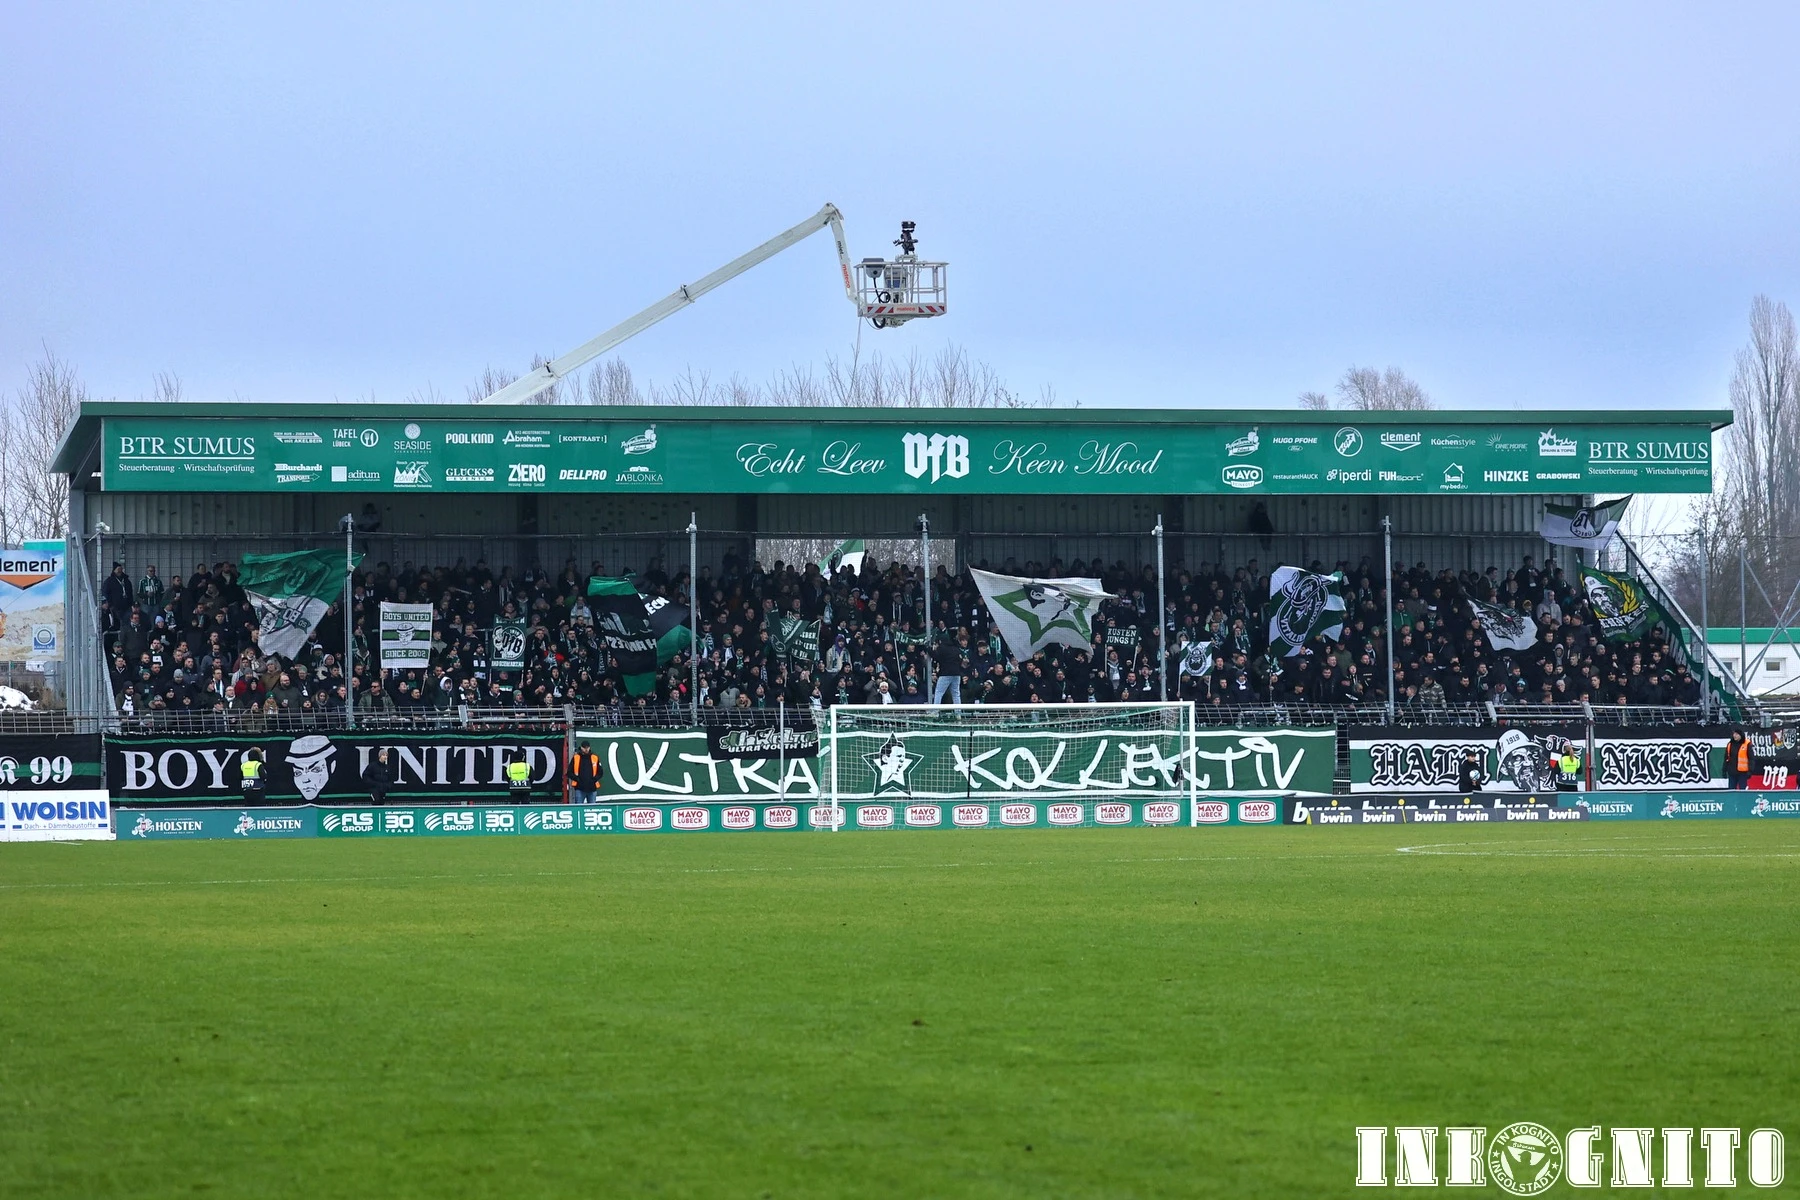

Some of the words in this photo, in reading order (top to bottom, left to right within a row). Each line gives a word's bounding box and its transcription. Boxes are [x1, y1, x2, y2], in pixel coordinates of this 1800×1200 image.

[333, 429, 357, 438] TAFEL
[502, 430, 542, 445] Abraham
[1380, 432, 1421, 442] clement
[120, 436, 167, 455] BTR
[173, 436, 255, 456] SUMUS
[332, 440, 351, 448] LÜBECK
[394, 440, 432, 450] SEASIDE
[1431, 438, 1476, 447] Küchenstyle
[1588, 442, 1630, 459] BTR
[1636, 441, 1709, 460] SUMUS
[736, 443, 806, 477] Echt
[817, 440, 887, 475] Leev
[901, 431, 970, 484] VfB
[988, 440, 1068, 475] Keen
[1074, 440, 1163, 475] Mood
[119, 463, 175, 473] Steuerberatung
[183, 463, 255, 474] Wirtschaftsprüfung
[1588, 467, 1638, 476] Steuerberatung
[1646, 467, 1709, 477] Wirtschaftsprüfung
[348, 470, 380, 479] aditum
[559, 469, 608, 480] DELLPRO
[616, 473, 664, 482] JABLONKA
[1226, 470, 1259, 480] MAYO
[1339, 469, 1372, 484] iperdi
[1484, 470, 1529, 482] HINZKE
[1536, 472, 1580, 480] GRABOWSKI
[383, 612, 402, 621] BOYS
[403, 612, 430, 621] UNITED
[1106, 636, 1129, 645] JUNGS
[385, 650, 406, 658] SINCE
[408, 650, 426, 658] 2002
[728, 744, 760, 753] ULTRA
[608, 741, 820, 795] ULTRA
[951, 736, 1305, 791] KOLLEKTIV
[29, 755, 73, 785] 99
[1762, 765, 1788, 790] VfB
[11, 801, 108, 822] WOISIN
[1592, 803, 1632, 813] HOLSTEN
[1682, 802, 1723, 812] HOLSTEN
[542, 810, 573, 823] FLS
[584, 812, 612, 826] 30
[1320, 812, 1353, 823] bwin
[1362, 811, 1395, 823] bwin
[1414, 810, 1447, 821] bwin
[1456, 810, 1489, 821] bwin
[1506, 808, 1539, 820] bwin
[1548, 808, 1580, 820] bwin
[257, 820, 301, 830] HOLSTEN
[342, 813, 374, 826] FLS
[385, 814, 414, 829] 30
[442, 812, 474, 824] FLS
[486, 814, 515, 828] 30
[24, 822, 42, 830] Dach-
[48, 822, 96, 830] Dämmbaustoffe
[155, 821, 202, 831] HOLSTEN
